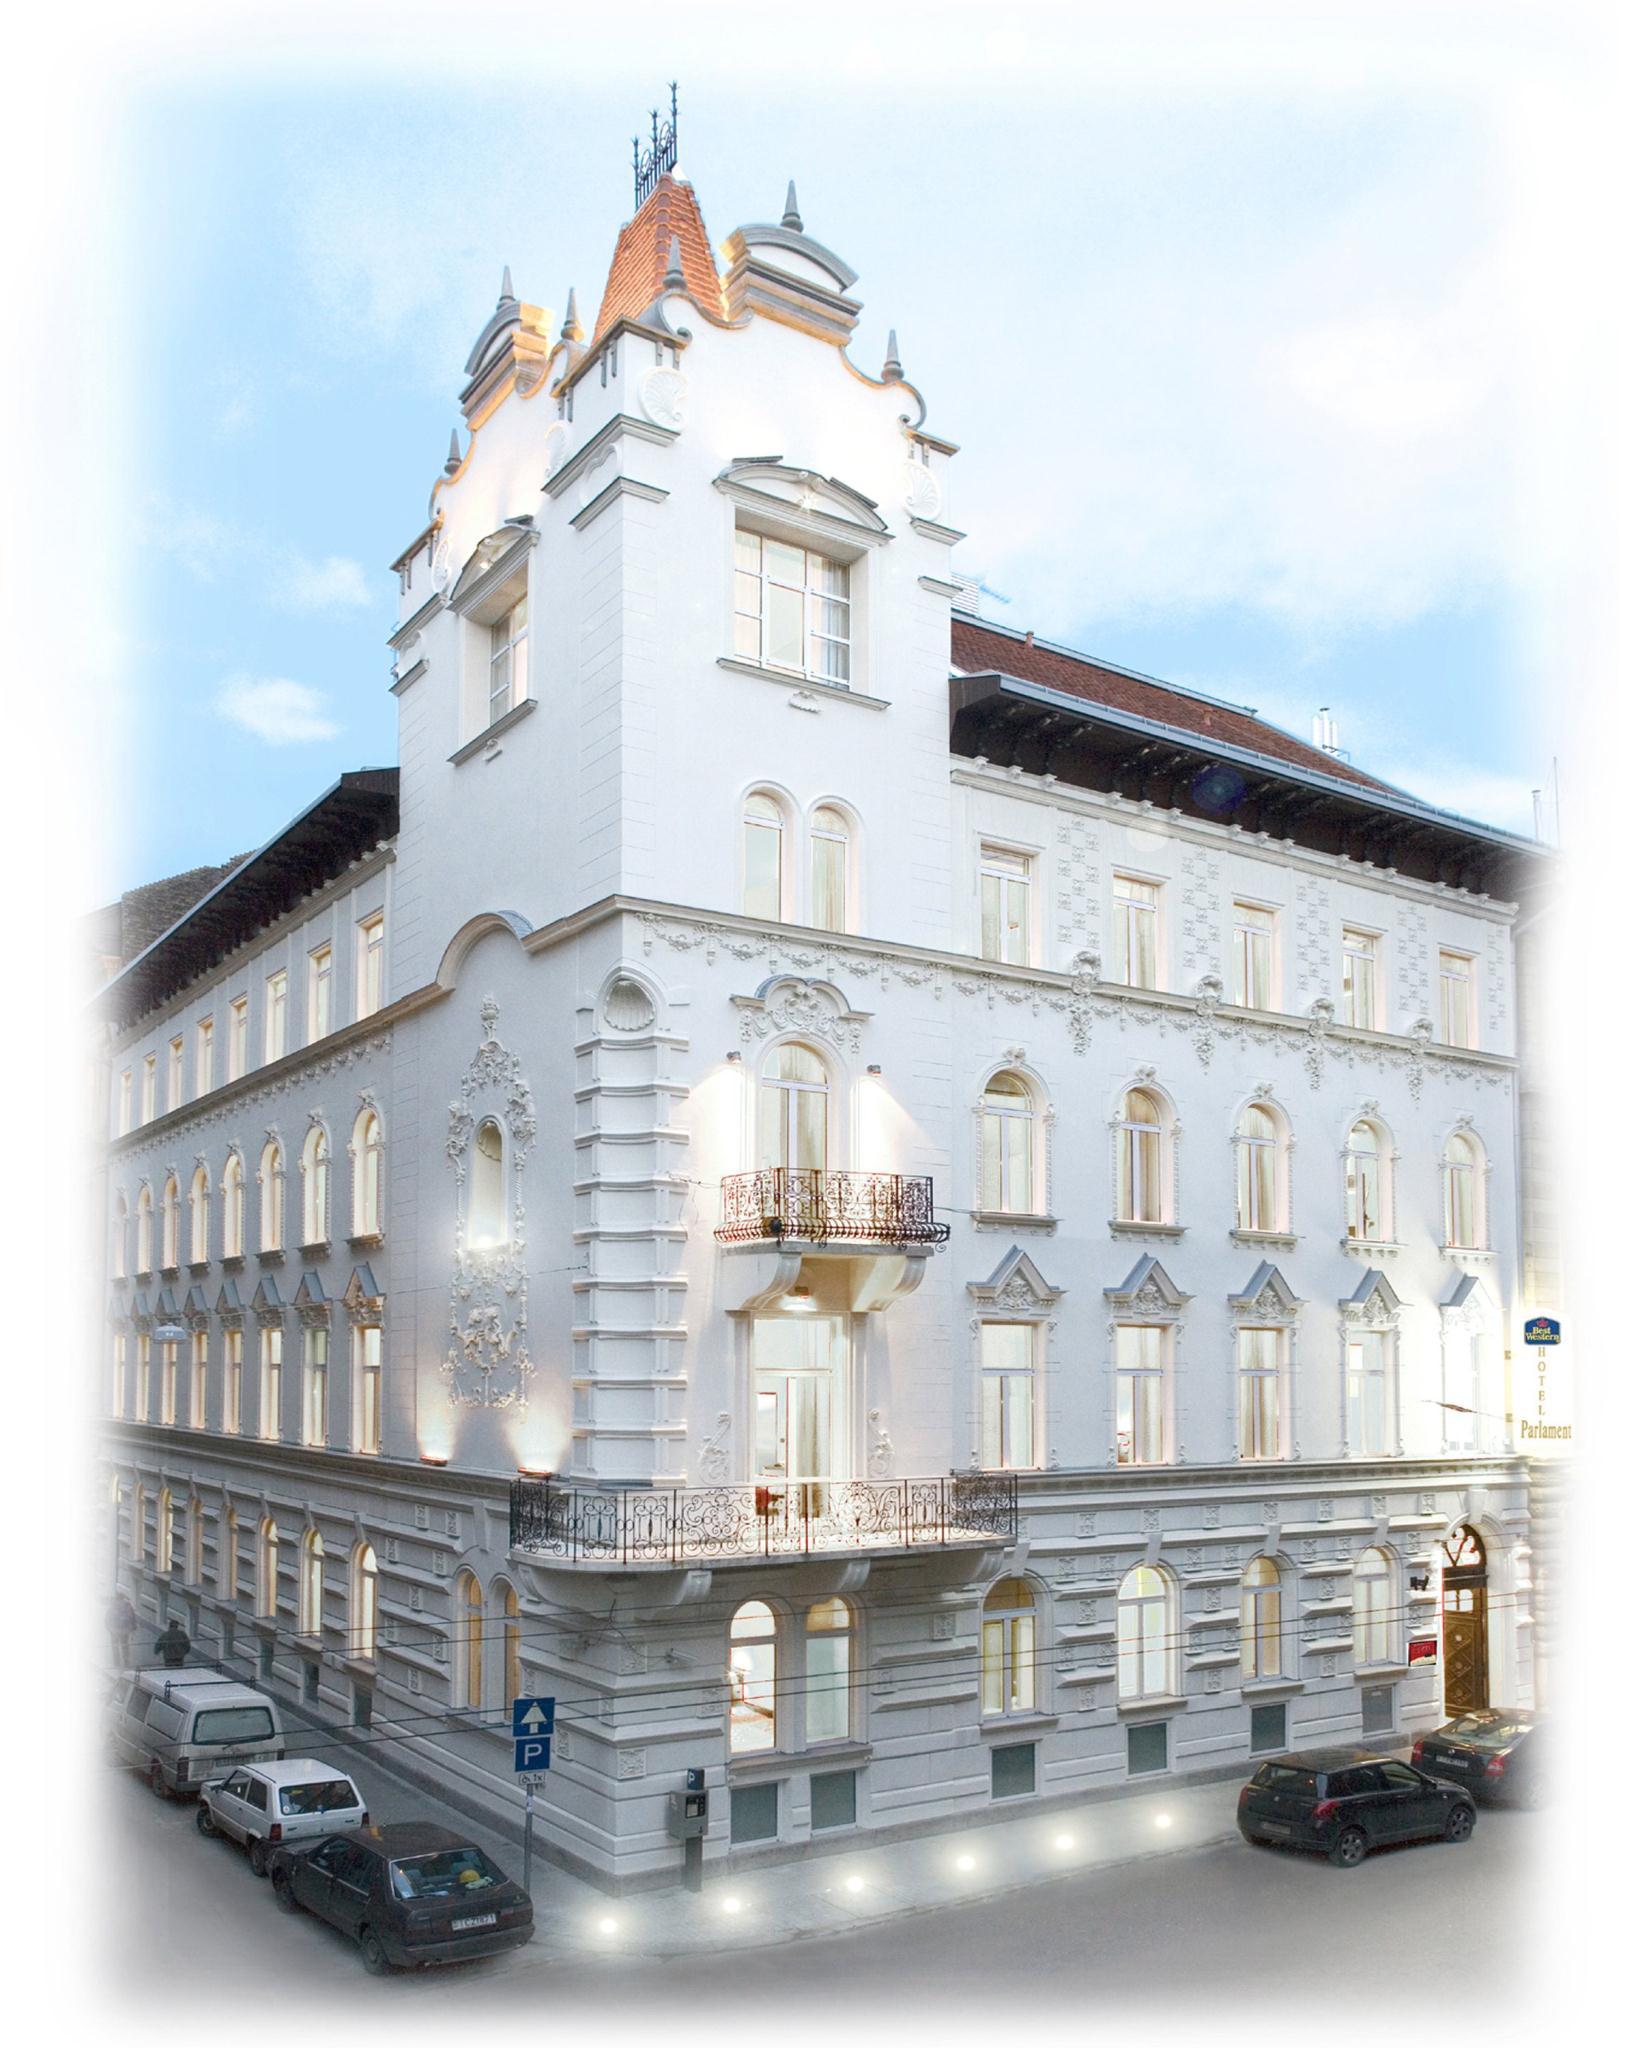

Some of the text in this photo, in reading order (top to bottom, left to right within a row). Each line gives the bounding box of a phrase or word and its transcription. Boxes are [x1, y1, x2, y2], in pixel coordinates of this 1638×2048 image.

[1525, 1333, 1561, 1344] Western
[1537, 1347, 1546, 1416] HOTEL
[1521, 1420, 1572, 1439] Parlament
[525, 1744, 543, 1765] P
[688, 1772, 696, 1784] P
